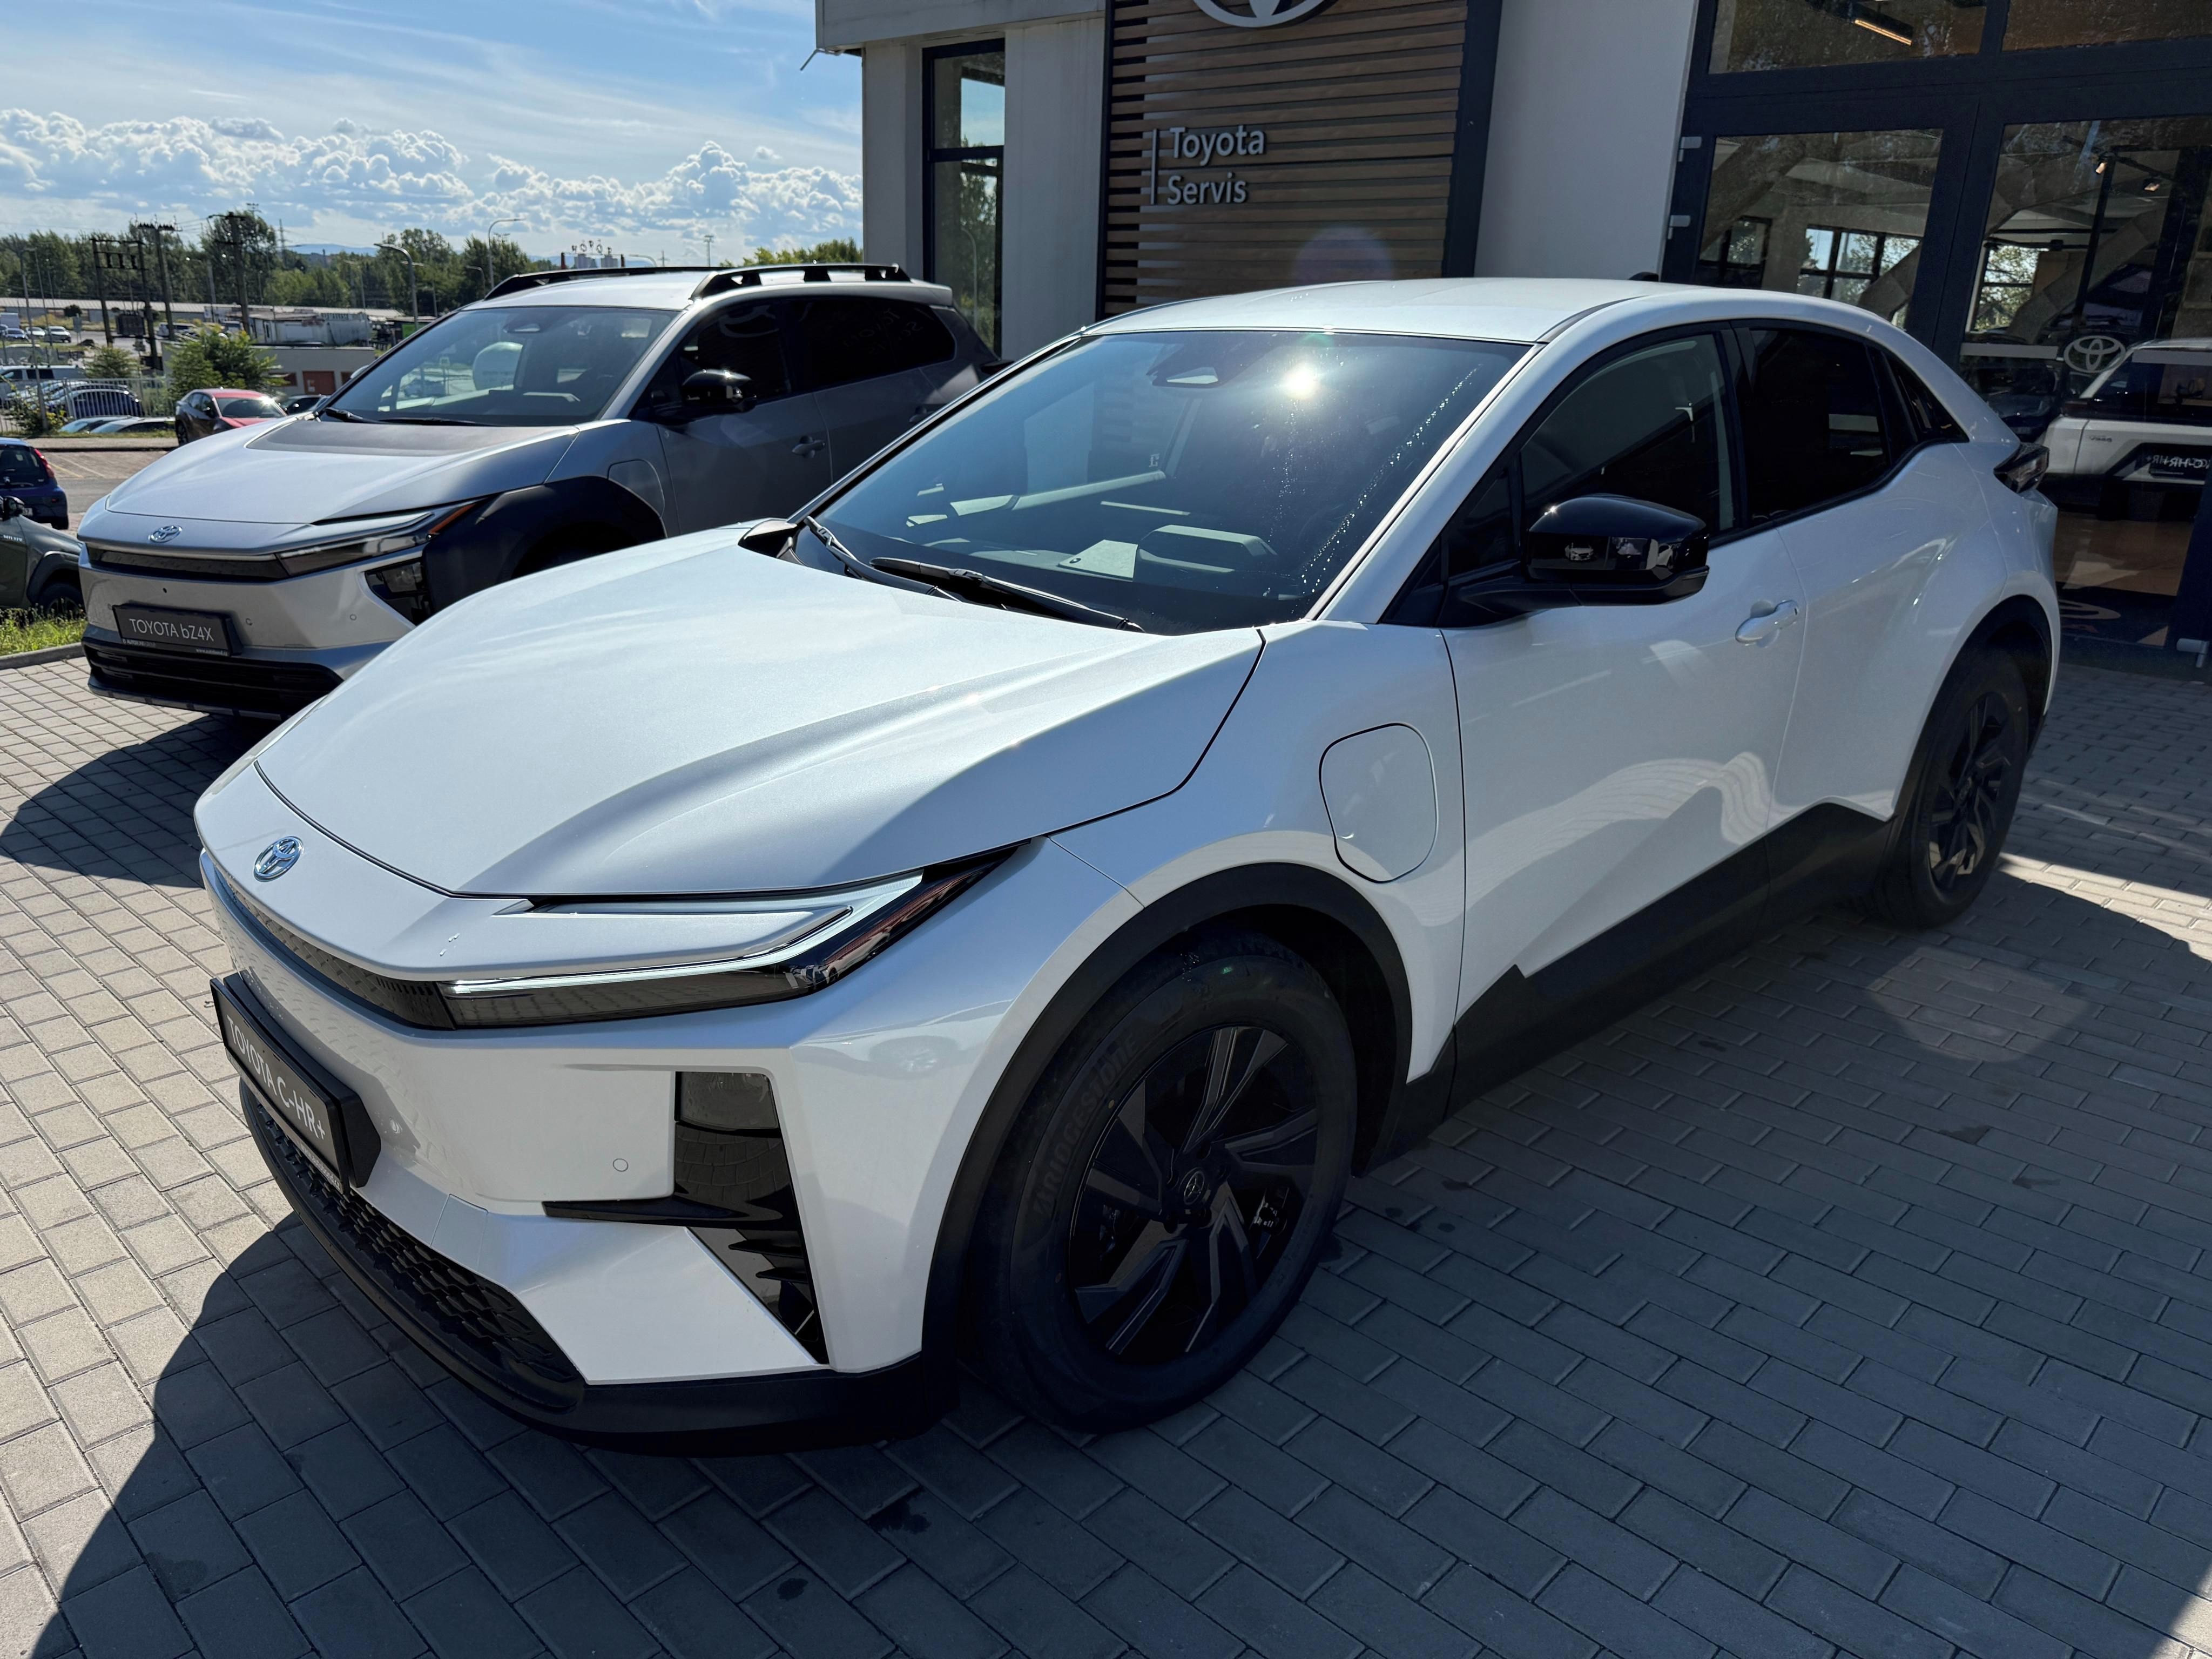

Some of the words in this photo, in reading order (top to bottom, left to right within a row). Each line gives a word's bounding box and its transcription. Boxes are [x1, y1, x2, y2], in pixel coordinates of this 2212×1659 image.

[1169, 125, 1266, 166] Toyota
[1166, 172, 1249, 205] Servis
[129, 618, 179, 638] TOYOTA
[180, 623, 214, 642] bZ4X
[226, 1015, 277, 1097] TOYOTA
[276, 1075, 326, 1140] C-HR+
